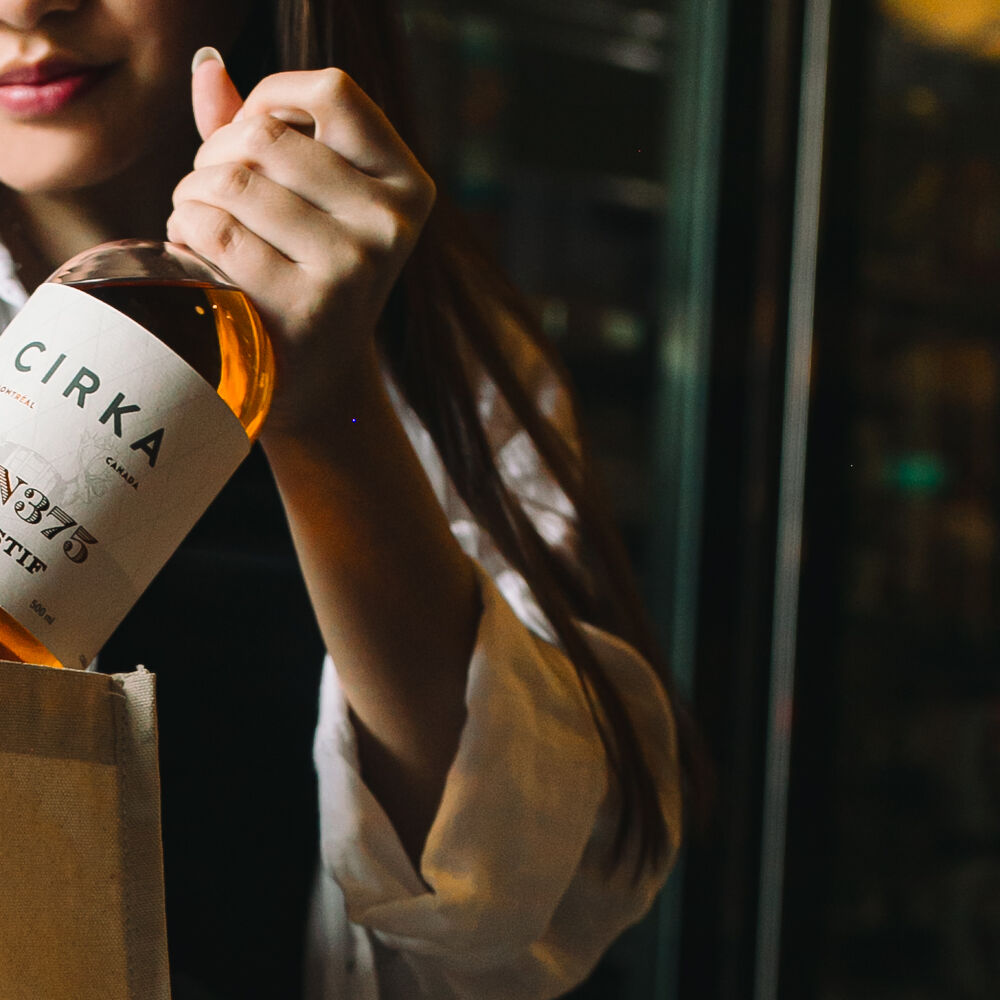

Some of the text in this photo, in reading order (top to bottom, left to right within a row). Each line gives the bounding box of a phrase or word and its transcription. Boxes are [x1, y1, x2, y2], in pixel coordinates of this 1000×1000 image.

[14, 341, 165, 468] CIRKA
[105, 456, 140, 490] CANADA
[29, 599, 46, 617] 500
